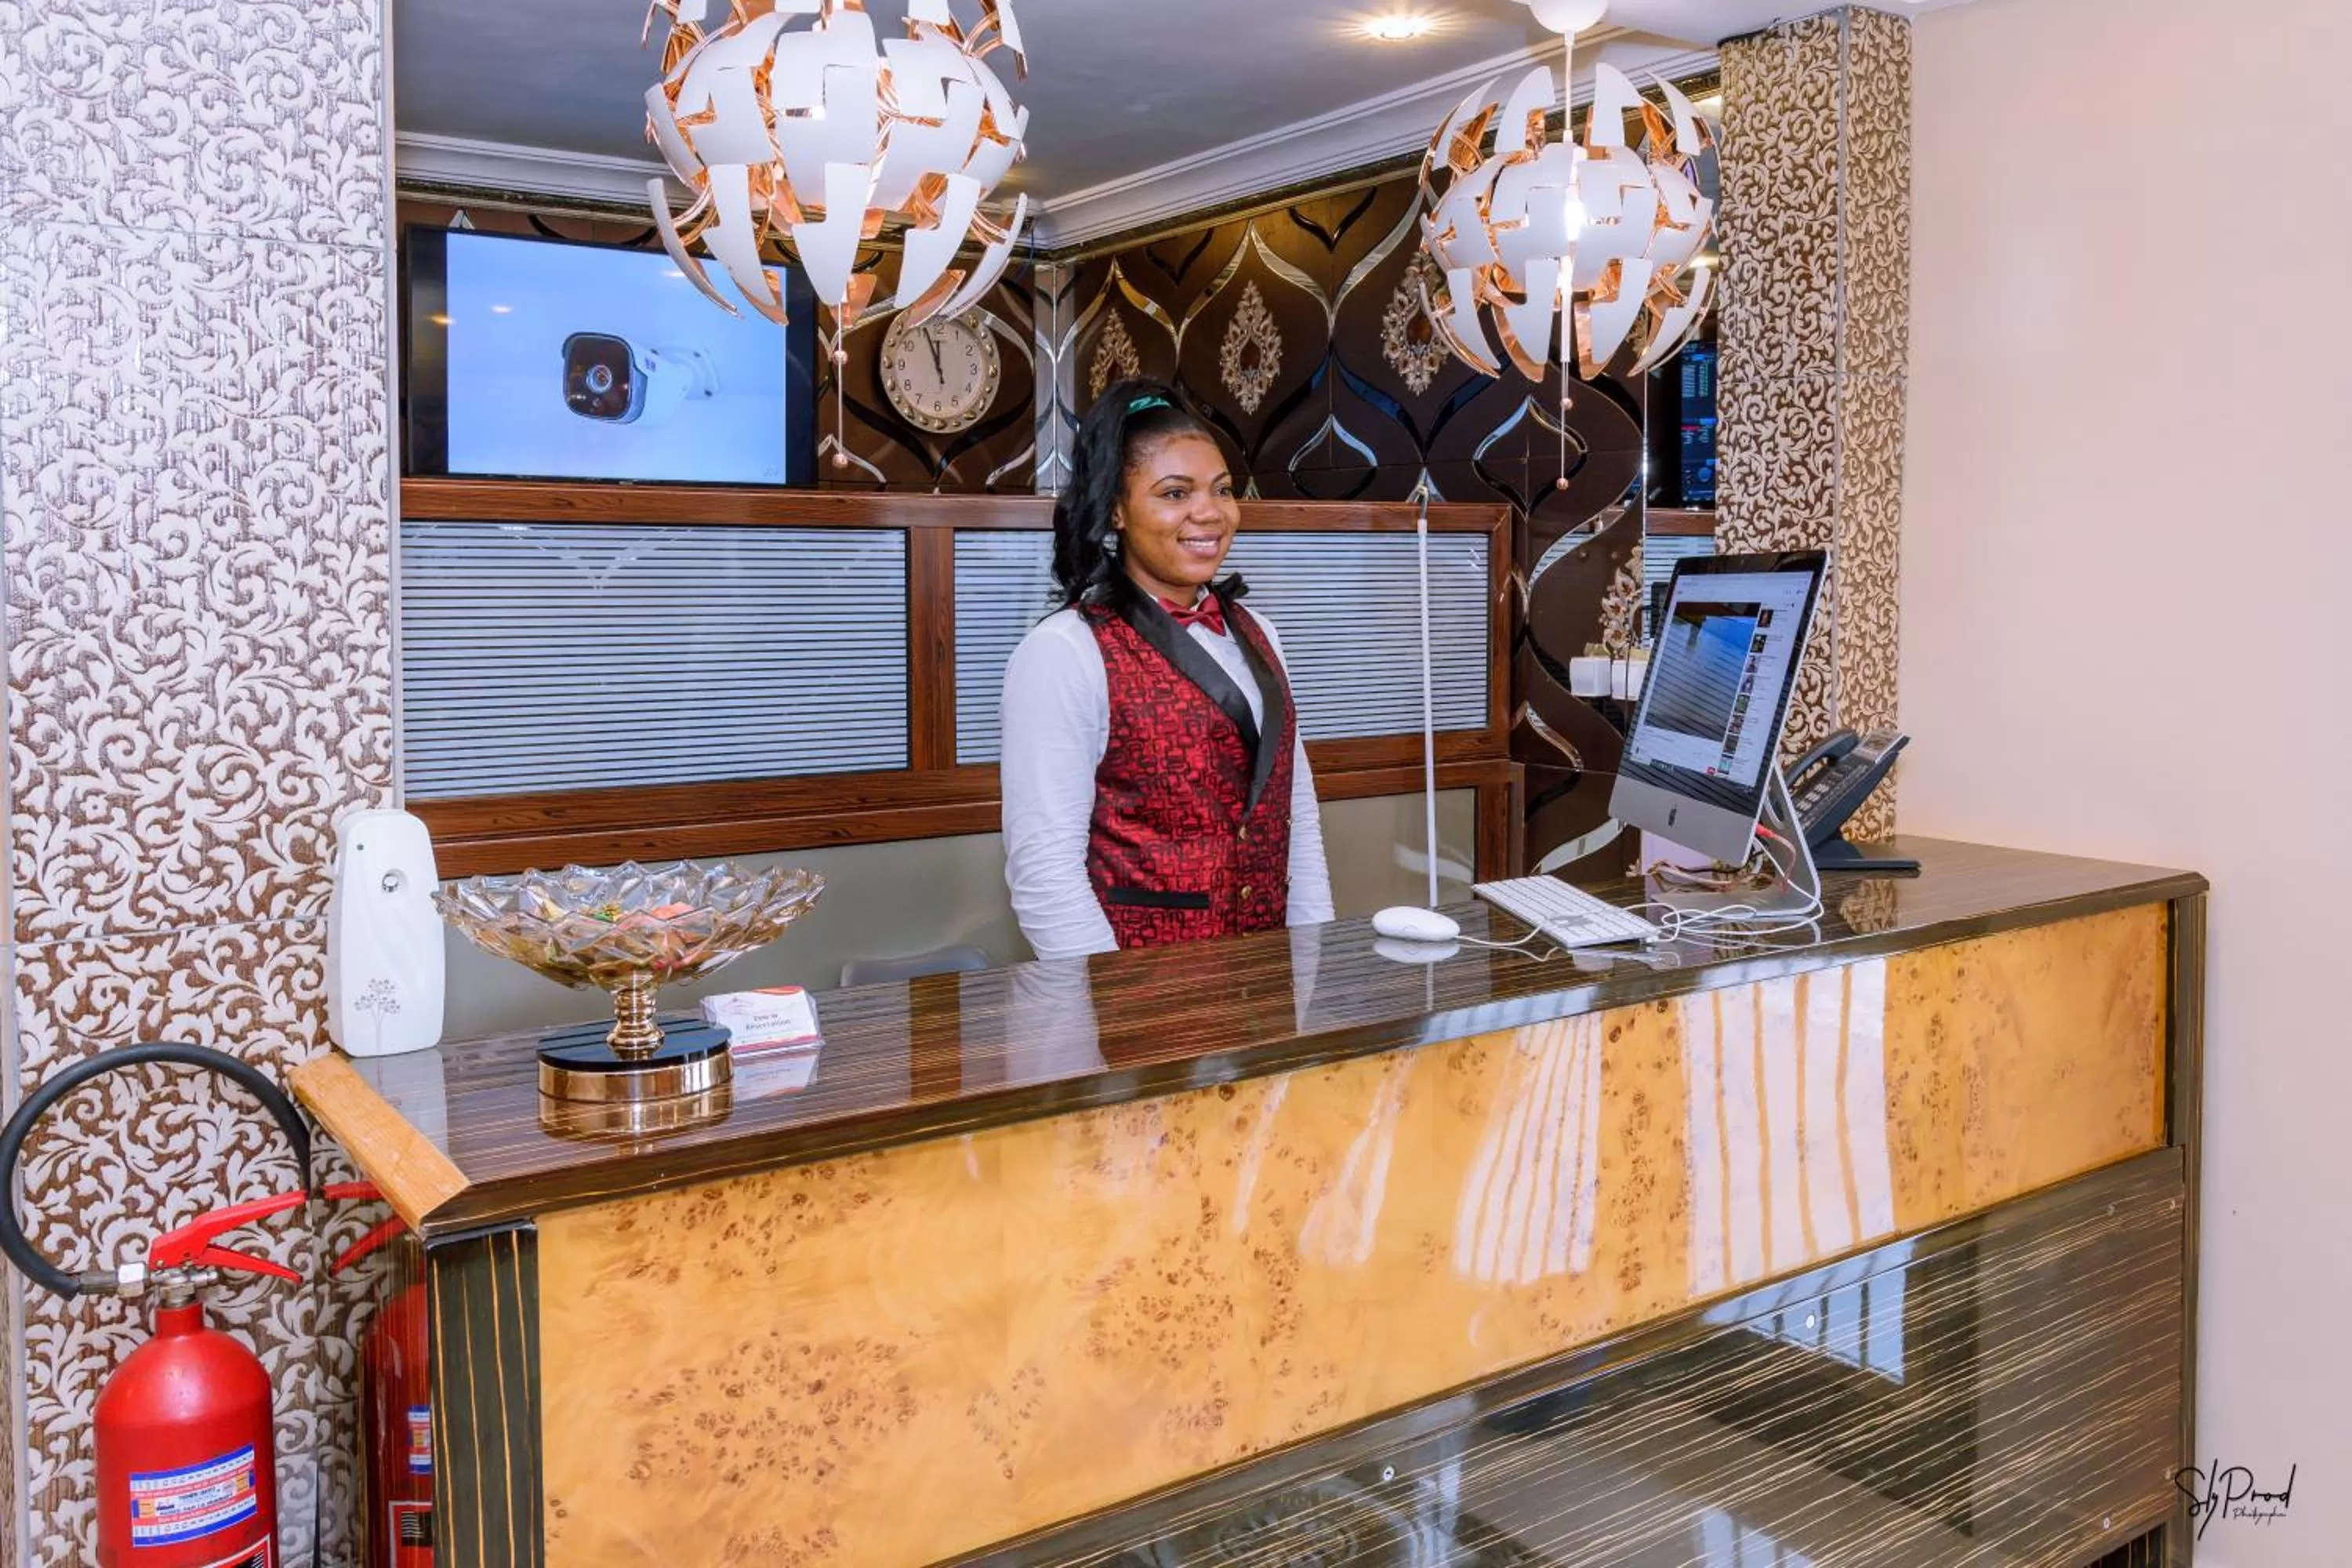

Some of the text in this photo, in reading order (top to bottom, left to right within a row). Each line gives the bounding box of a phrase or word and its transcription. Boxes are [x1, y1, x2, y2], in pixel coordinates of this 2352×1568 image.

[903, 339, 915, 352] 10
[965, 345, 973, 356] 2
[898, 359, 906, 370] 9
[970, 364, 978, 375] 3
[904, 379, 912, 390] 8
[965, 382, 972, 394] 4
[915, 394, 923, 405] 7
[951, 395, 959, 407] 5
[934, 401, 941, 412] 6
